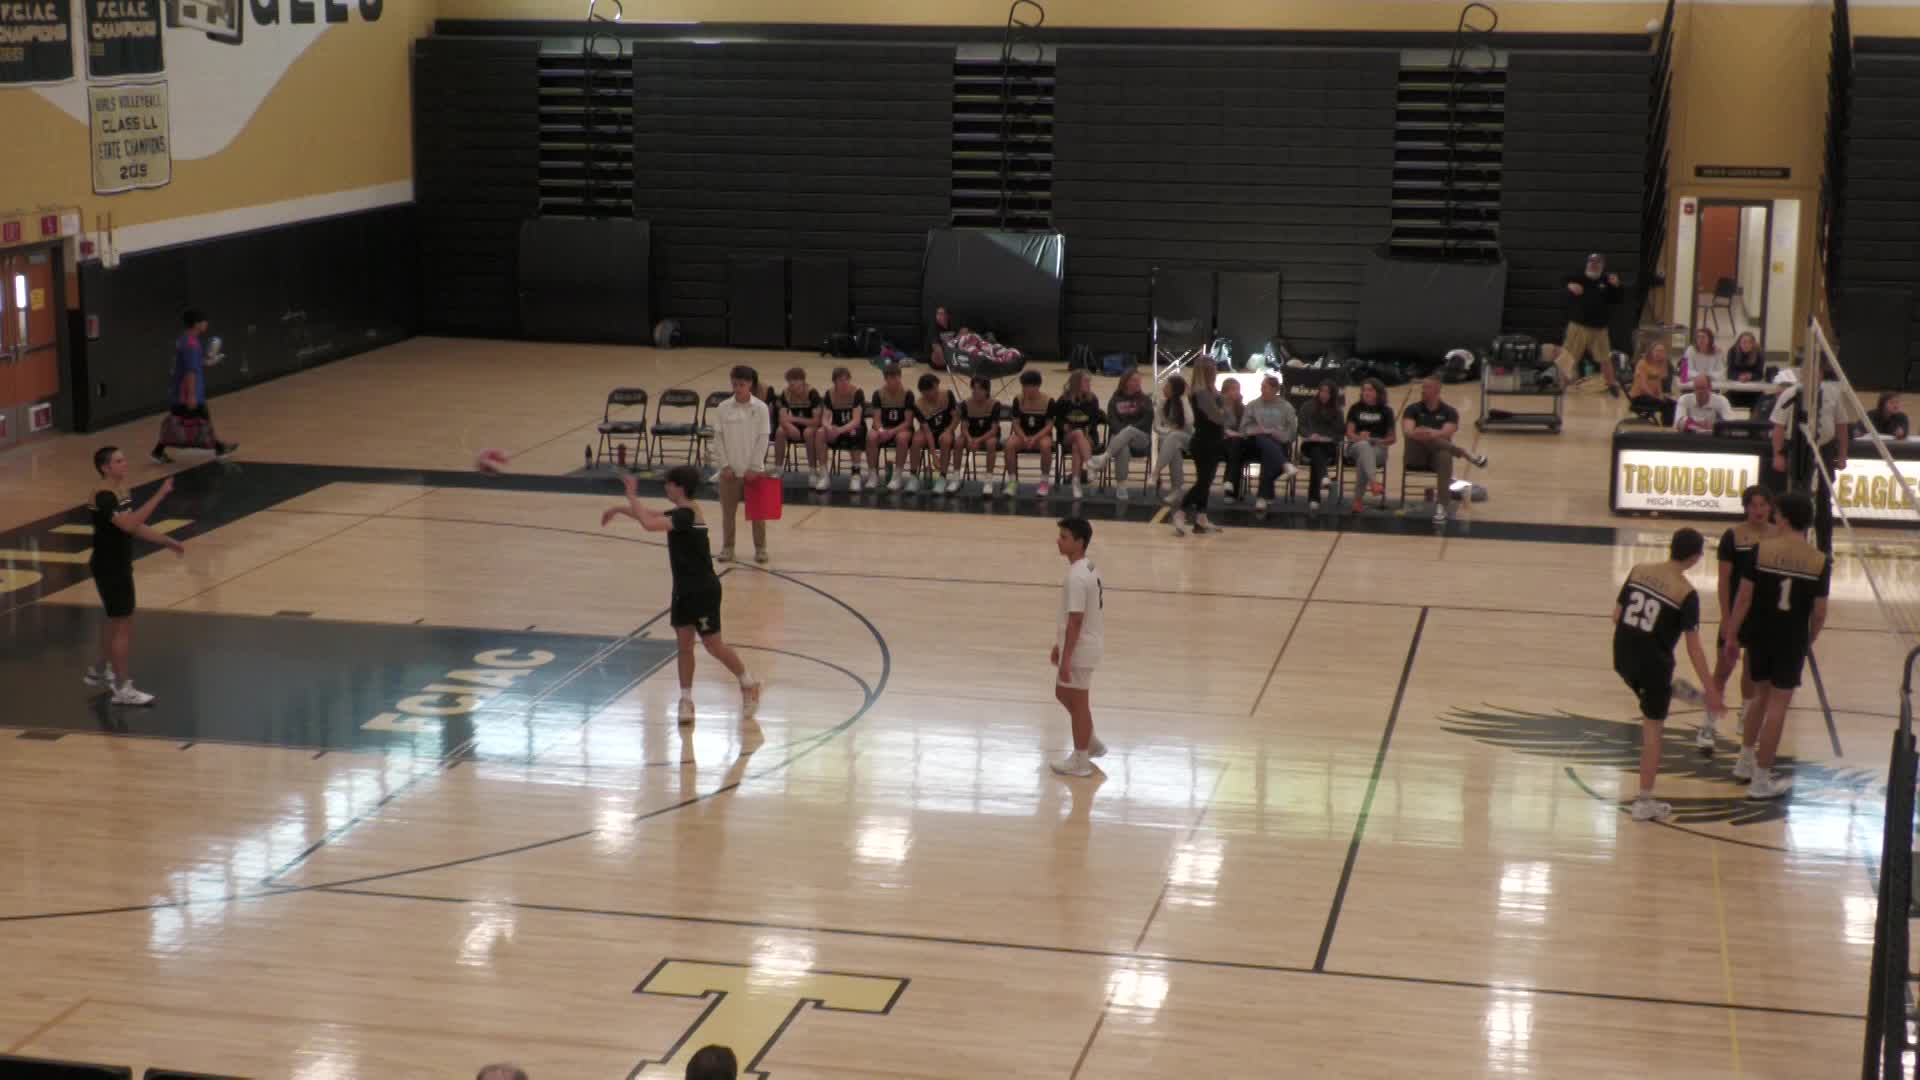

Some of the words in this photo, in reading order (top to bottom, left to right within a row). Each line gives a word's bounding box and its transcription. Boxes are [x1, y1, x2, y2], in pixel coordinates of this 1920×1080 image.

[102, 117, 140, 133] CLASS
[143, 116, 158, 130] LL
[1623, 463, 1748, 497] TRUMBULL
[1838, 473, 1920, 510] EAGLE
[1646, 498, 1673, 506] HIGH
[1676, 499, 1719, 508] SCHOOL
[1623, 591, 1661, 632] 29
[1778, 577, 1792, 611] 1
[360, 648, 556, 733] FCIAC
[627, 957, 911, 1080] T
